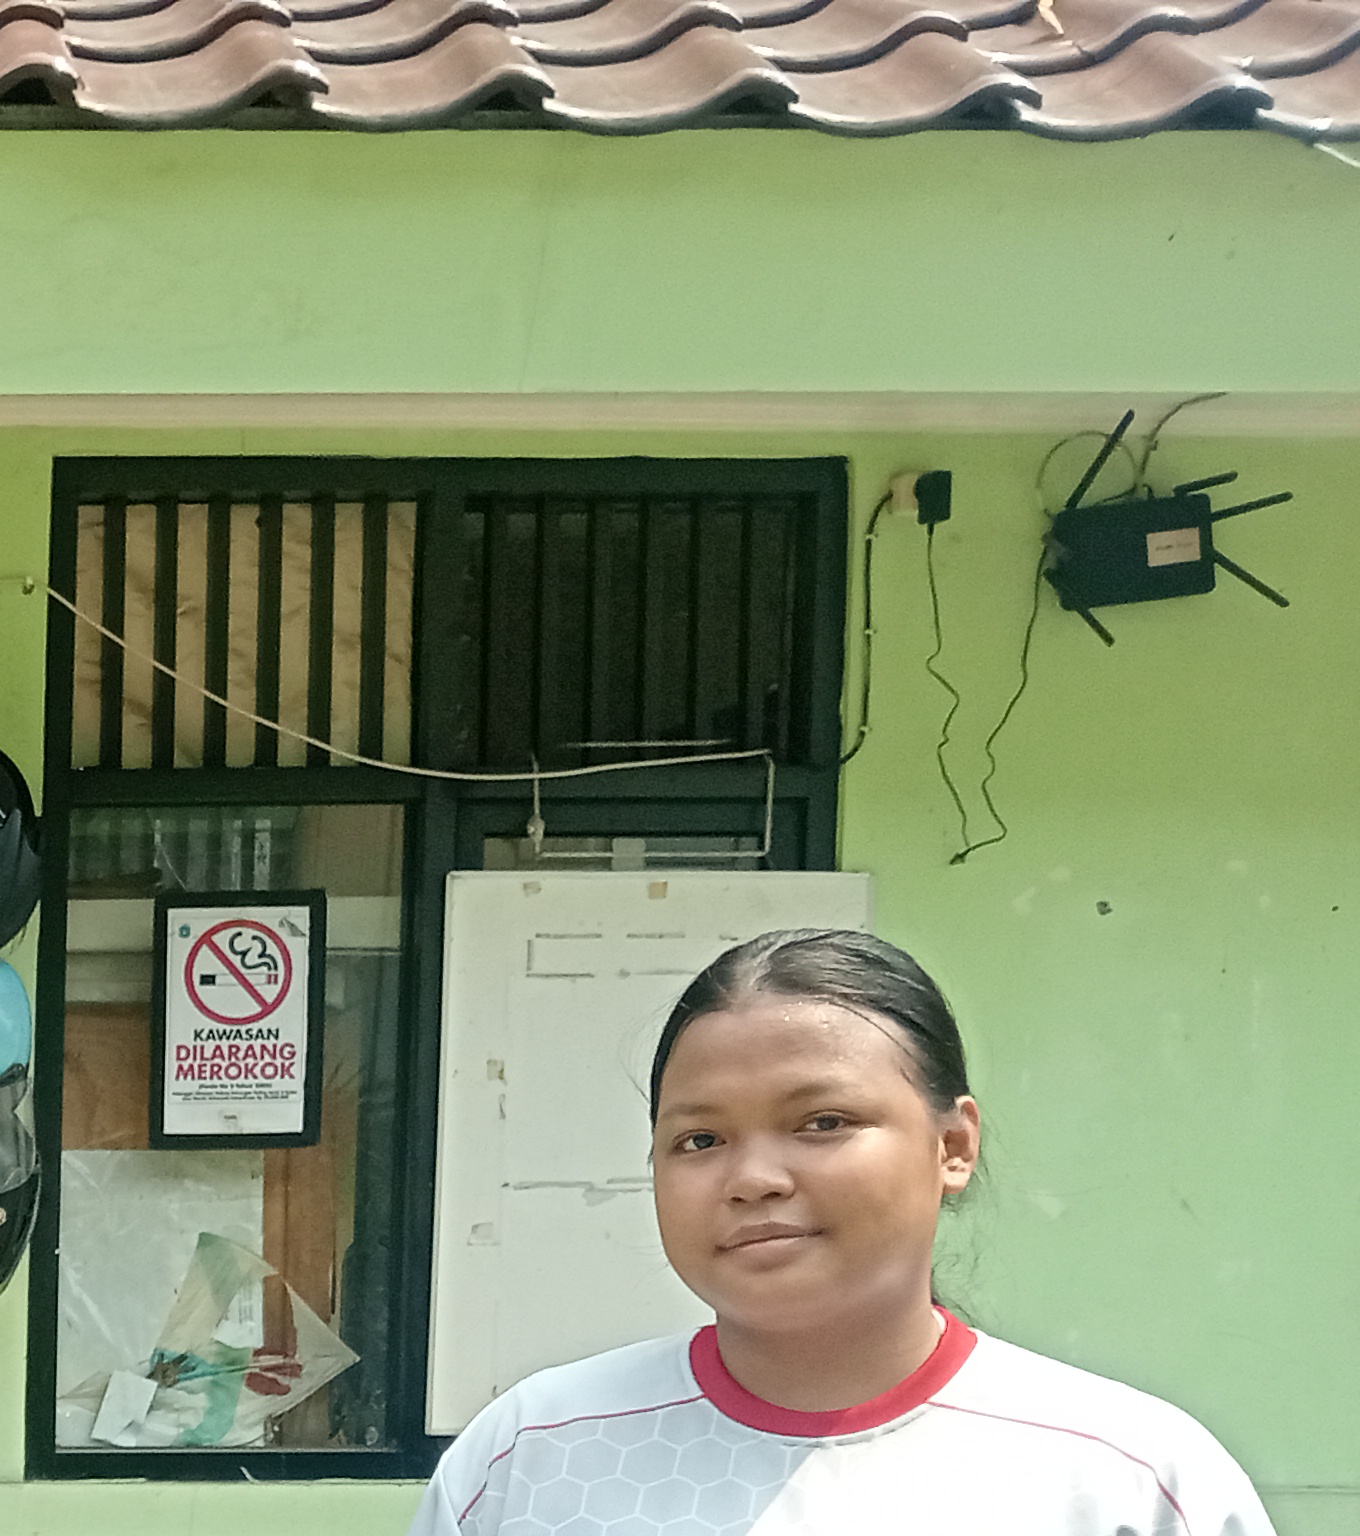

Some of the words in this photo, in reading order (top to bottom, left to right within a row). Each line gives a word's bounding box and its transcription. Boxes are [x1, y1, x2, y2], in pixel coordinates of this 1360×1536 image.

[193, 1027, 280, 1042] KAWASAN
[175, 1042, 297, 1062] DILARANG
[175, 1062, 296, 1081] MEROKOK
